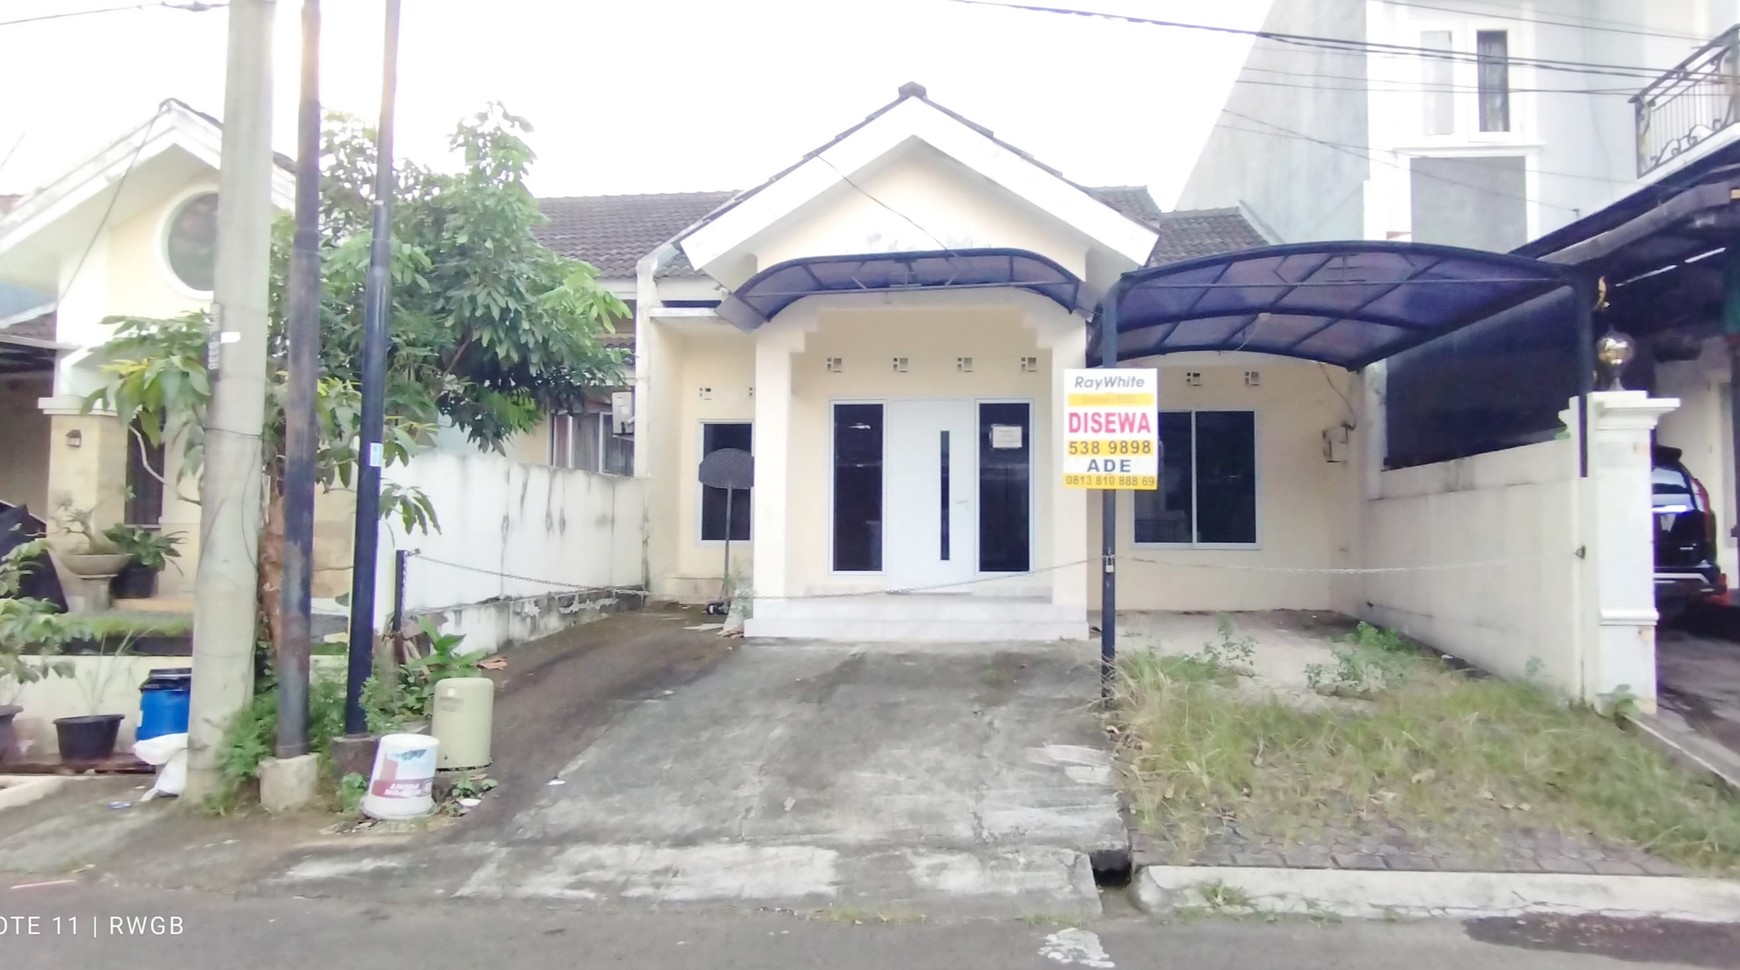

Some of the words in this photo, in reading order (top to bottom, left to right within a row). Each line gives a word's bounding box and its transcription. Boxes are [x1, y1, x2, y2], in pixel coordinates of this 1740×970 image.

[1068, 412, 1151, 433] DISEWA
[1069, 441, 1100, 455] 538
[1108, 440, 1151, 454] 9898
[1087, 459, 1132, 473] ADE
[1066, 475, 1092, 485] 0813
[1095, 475, 1116, 486] 810
[1119, 475, 1138, 486] 888
[1142, 476, 1155, 486] 69
